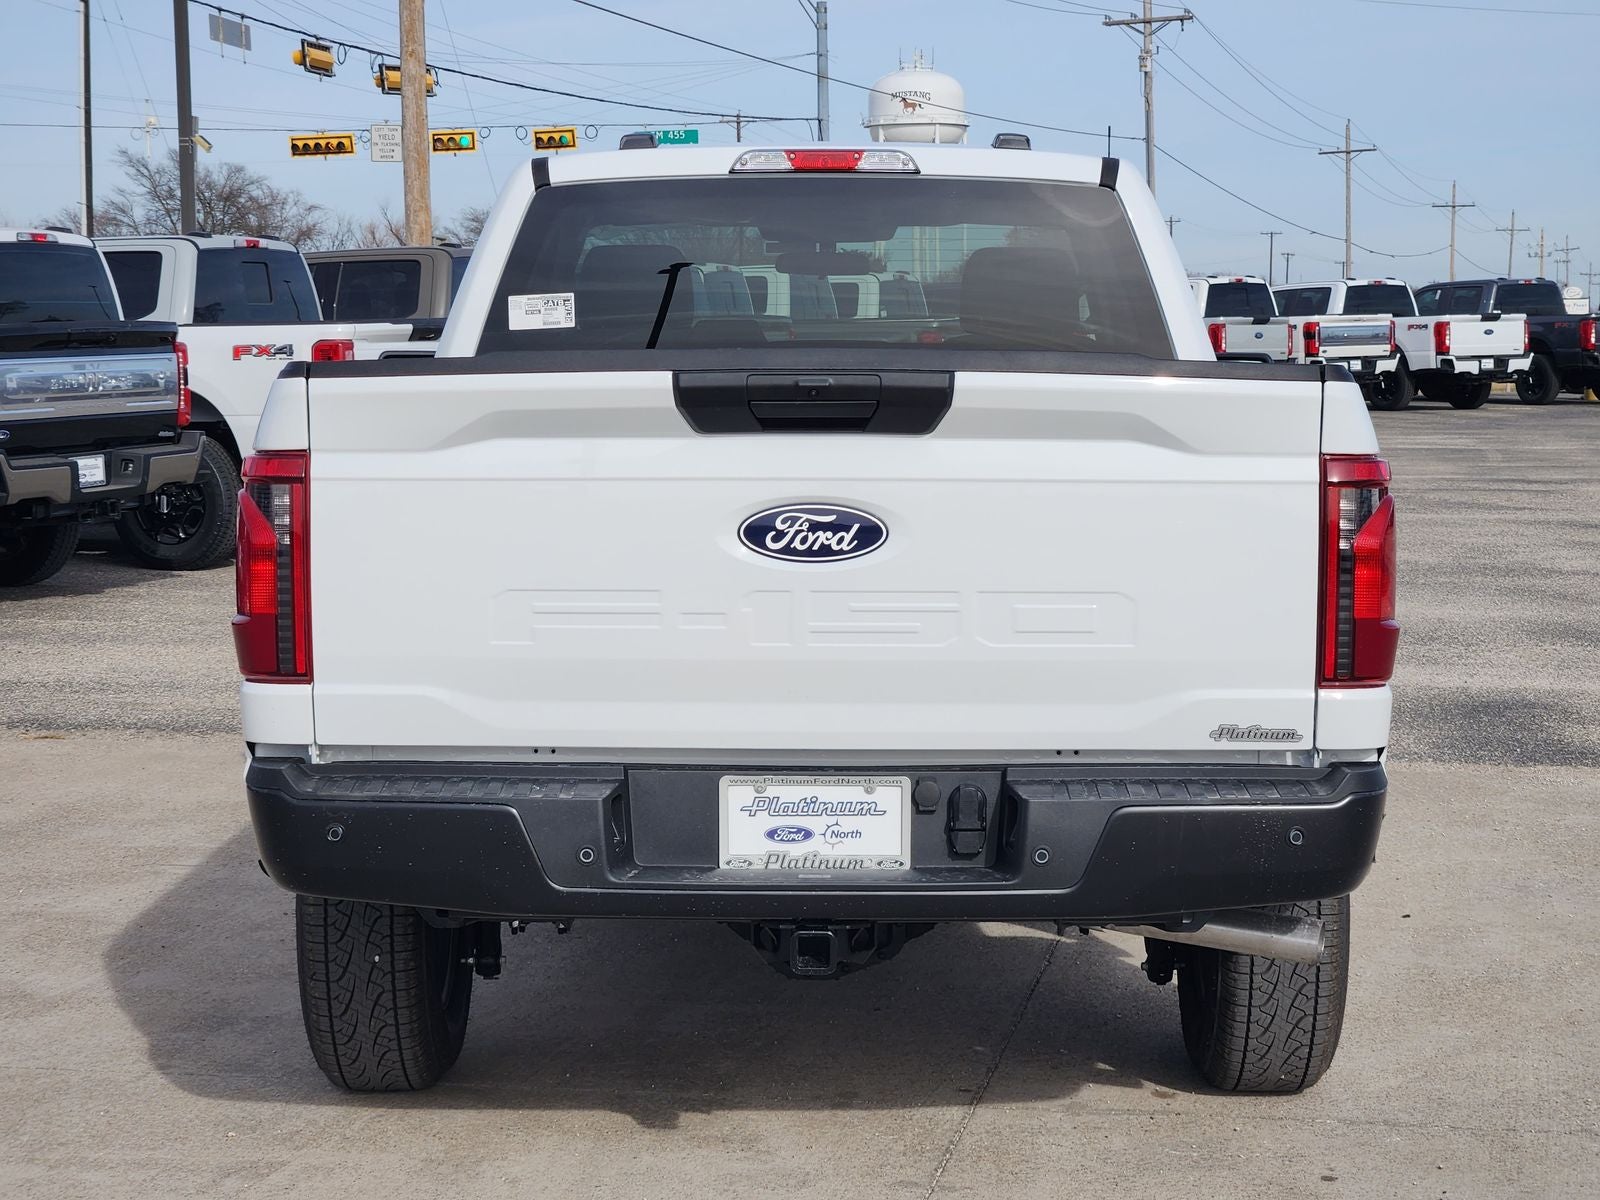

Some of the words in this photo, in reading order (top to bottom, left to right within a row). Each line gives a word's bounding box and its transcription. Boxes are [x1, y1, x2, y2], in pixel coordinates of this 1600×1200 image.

[891, 91, 931, 101] MUSTANG
[378, 133, 396, 141] YIELD
[668, 130, 686, 140] 455
[565, 299, 573, 323] RETAIL
[232, 344, 294, 360] FX4
[765, 512, 860, 551] Ford
[489, 589, 1137, 648] F-150
[1209, 724, 1303, 742] Platinum
[729, 777, 902, 785] www.PlatinumFordNorth.com
[740, 796, 887, 817] Platinum
[774, 827, 805, 841] Ford
[830, 829, 862, 839] North
[763, 851, 871, 869] Platinum
